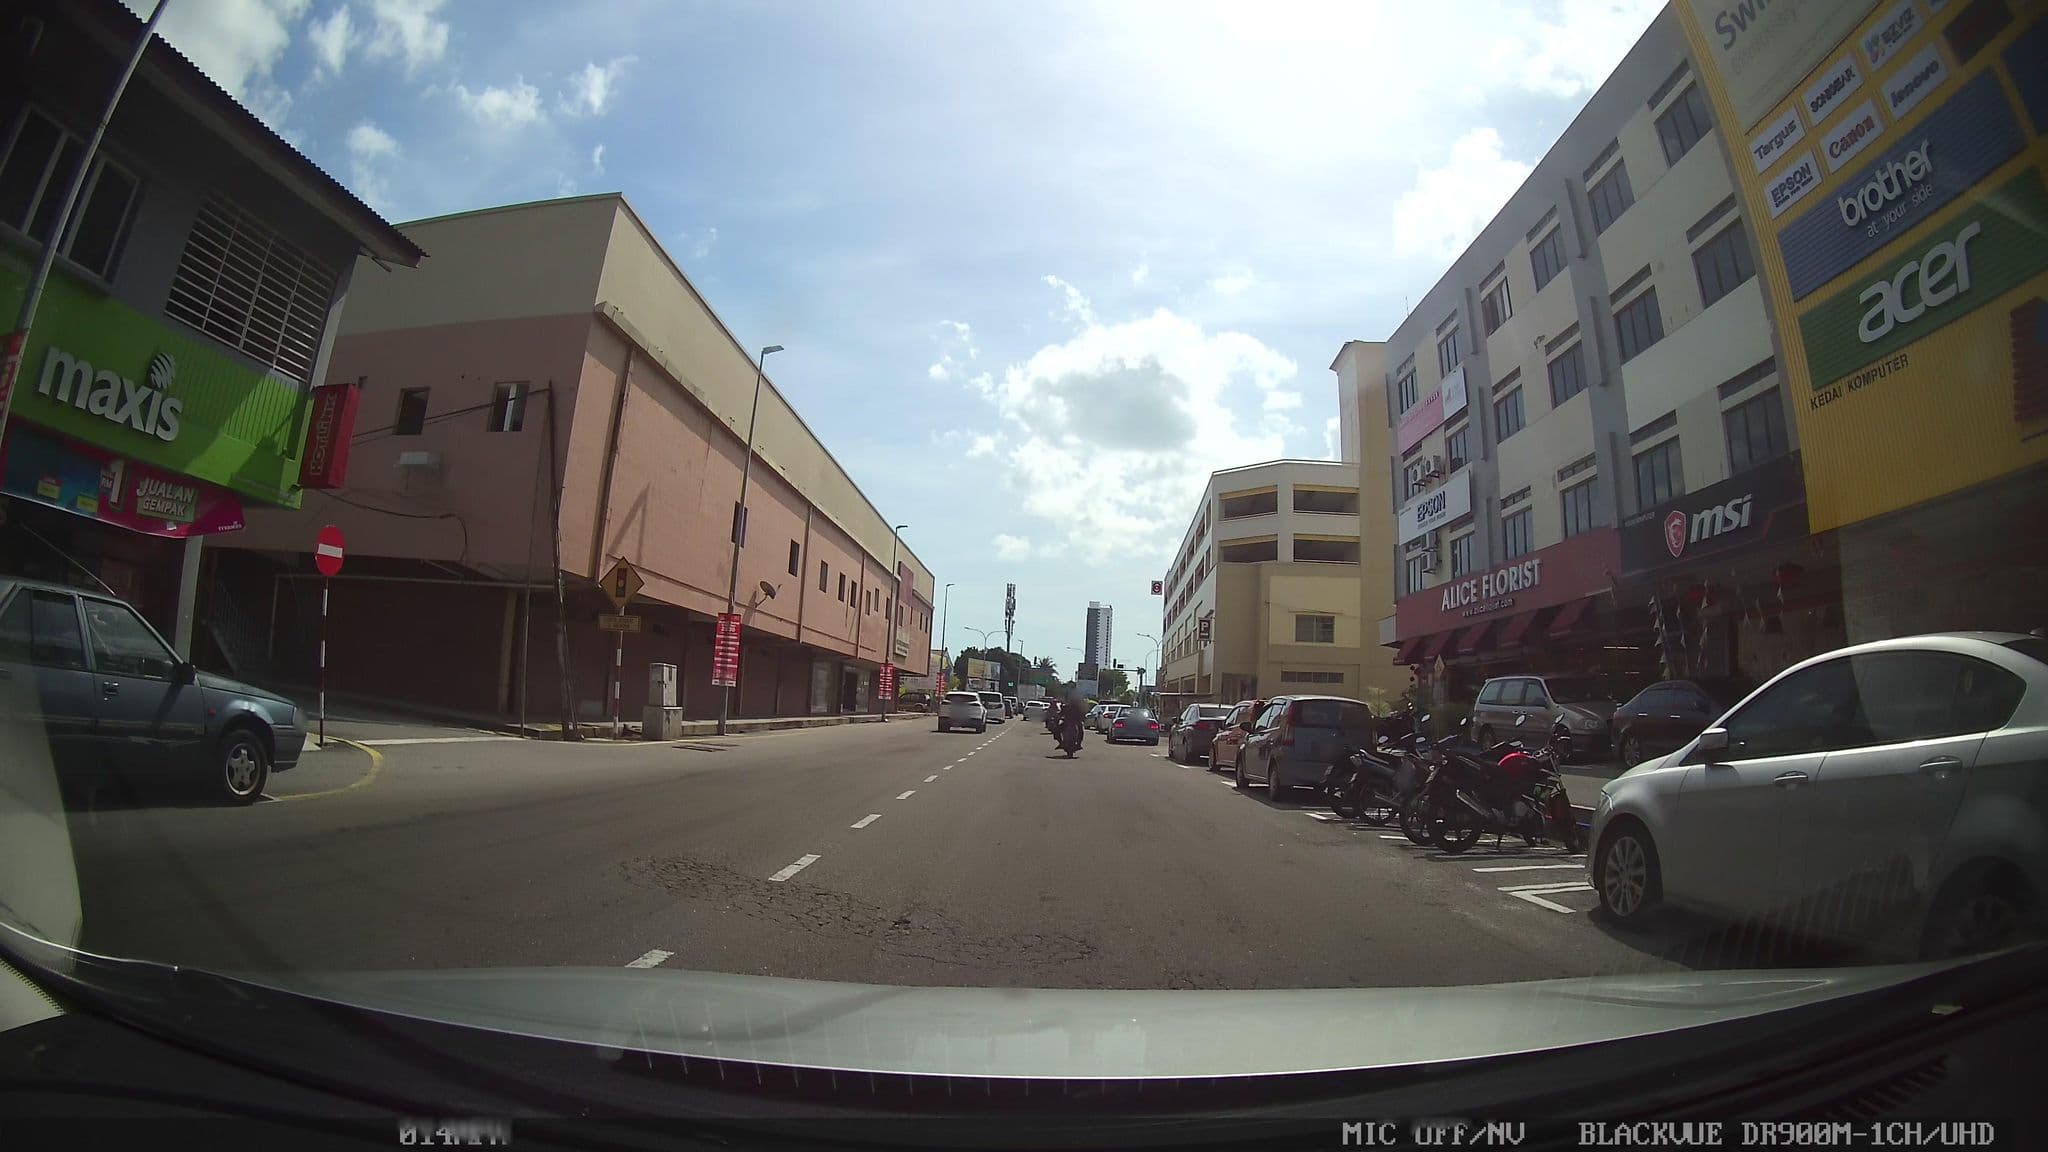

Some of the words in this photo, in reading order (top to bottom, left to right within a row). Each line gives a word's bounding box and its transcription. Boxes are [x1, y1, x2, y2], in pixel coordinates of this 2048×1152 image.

[1753, 120, 1797, 159] Targus
[1829, 115, 1875, 159] Canon
[1771, 162, 1811, 203] EPSON
[1837, 139, 1933, 227] brother
[1867, 221, 1880, 238] at
[1882, 201, 1907, 231] your
[1911, 183, 1934, 208] side
[1858, 221, 1981, 343] acer
[38, 346, 184, 442] maxis
[1810, 385, 1842, 410] KEDAI
[1847, 353, 1909, 392] KOMPUTER
[136, 477, 194, 503] JUALAN
[143, 498, 186, 517] GEMPAK
[1417, 490, 1446, 522] EPSON
[1689, 492, 1753, 544] msi
[1441, 579, 1478, 612] ALICE
[1482, 559, 1542, 599] FLORIST
[1201, 621, 1209, 632] P
